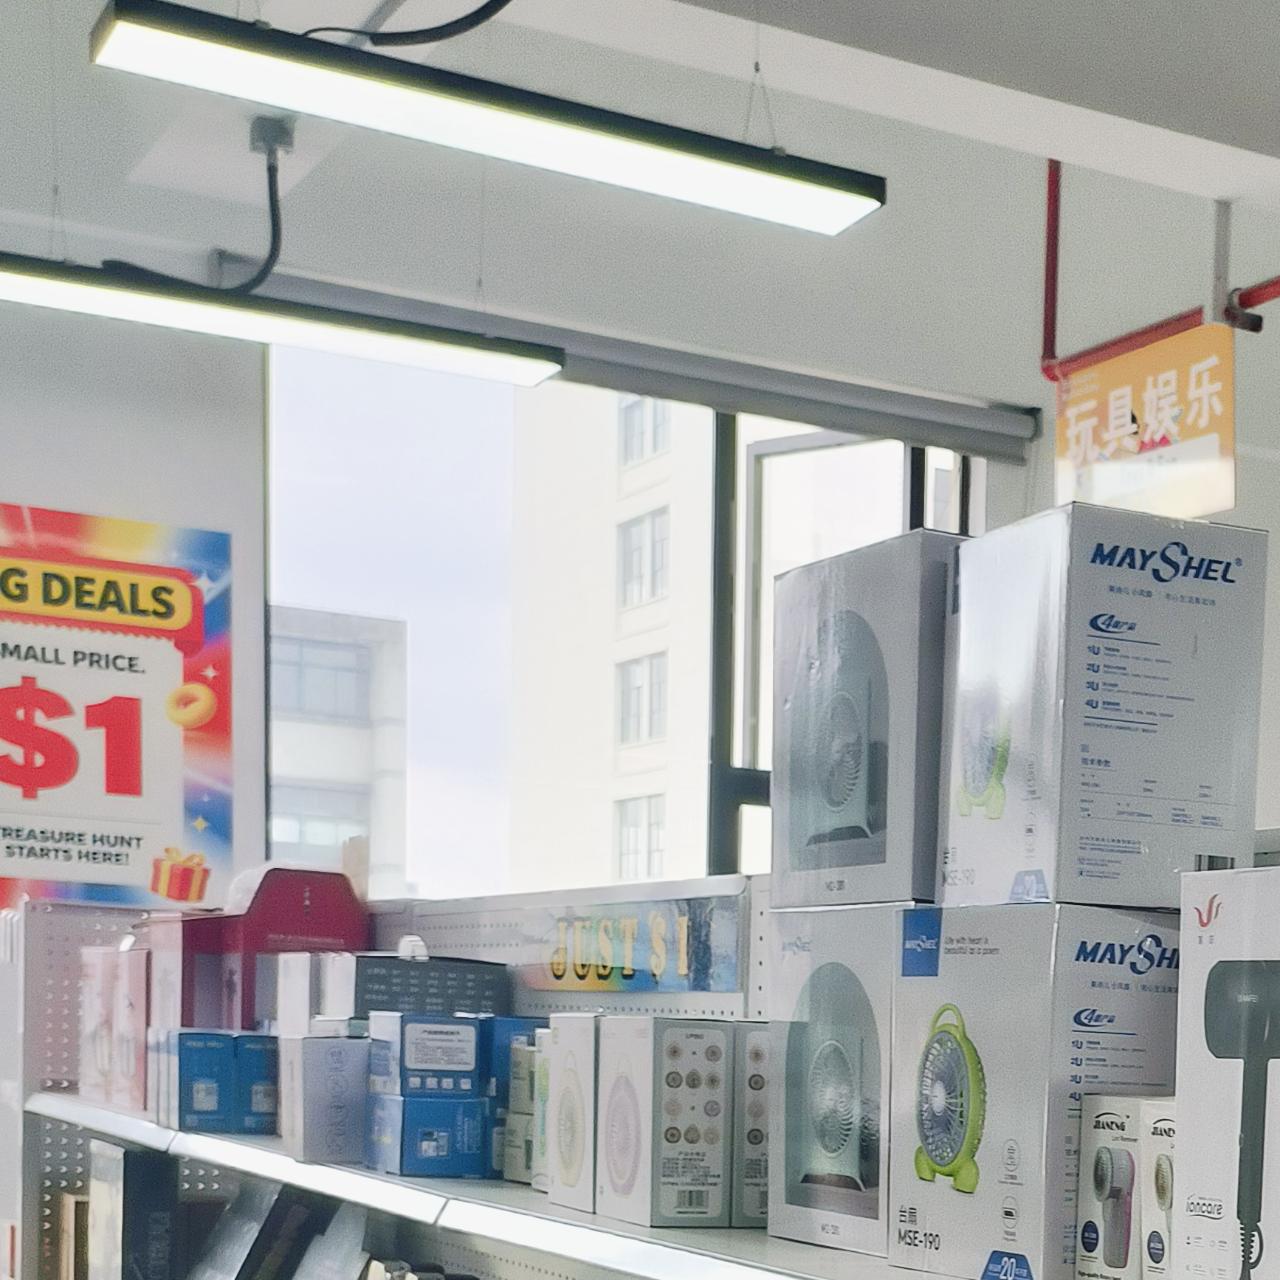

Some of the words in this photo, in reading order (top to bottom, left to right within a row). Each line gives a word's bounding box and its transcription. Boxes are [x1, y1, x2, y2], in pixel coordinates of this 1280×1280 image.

[1065, 355, 1224, 468] 玩具娱乐
[1090, 542, 1236, 583] MAYSHEL
[0, 567, 28, 603] G
[42, 571, 176, 620] DEALS
[0, 642, 66, 665] MALL
[73, 650, 146, 674] PRICE.
[0, 676, 143, 799] $1
[5, 845, 73, 862] STARTS
[78, 849, 130, 866] HERE!
[92, 833, 144, 849] HUNT
[552, 916, 637, 980] JUST
[1186, 1201, 1224, 1215] ioncare
[897, 1228, 941, 1251] MSE-190
[1000, 1257, 1017, 1280] 20
